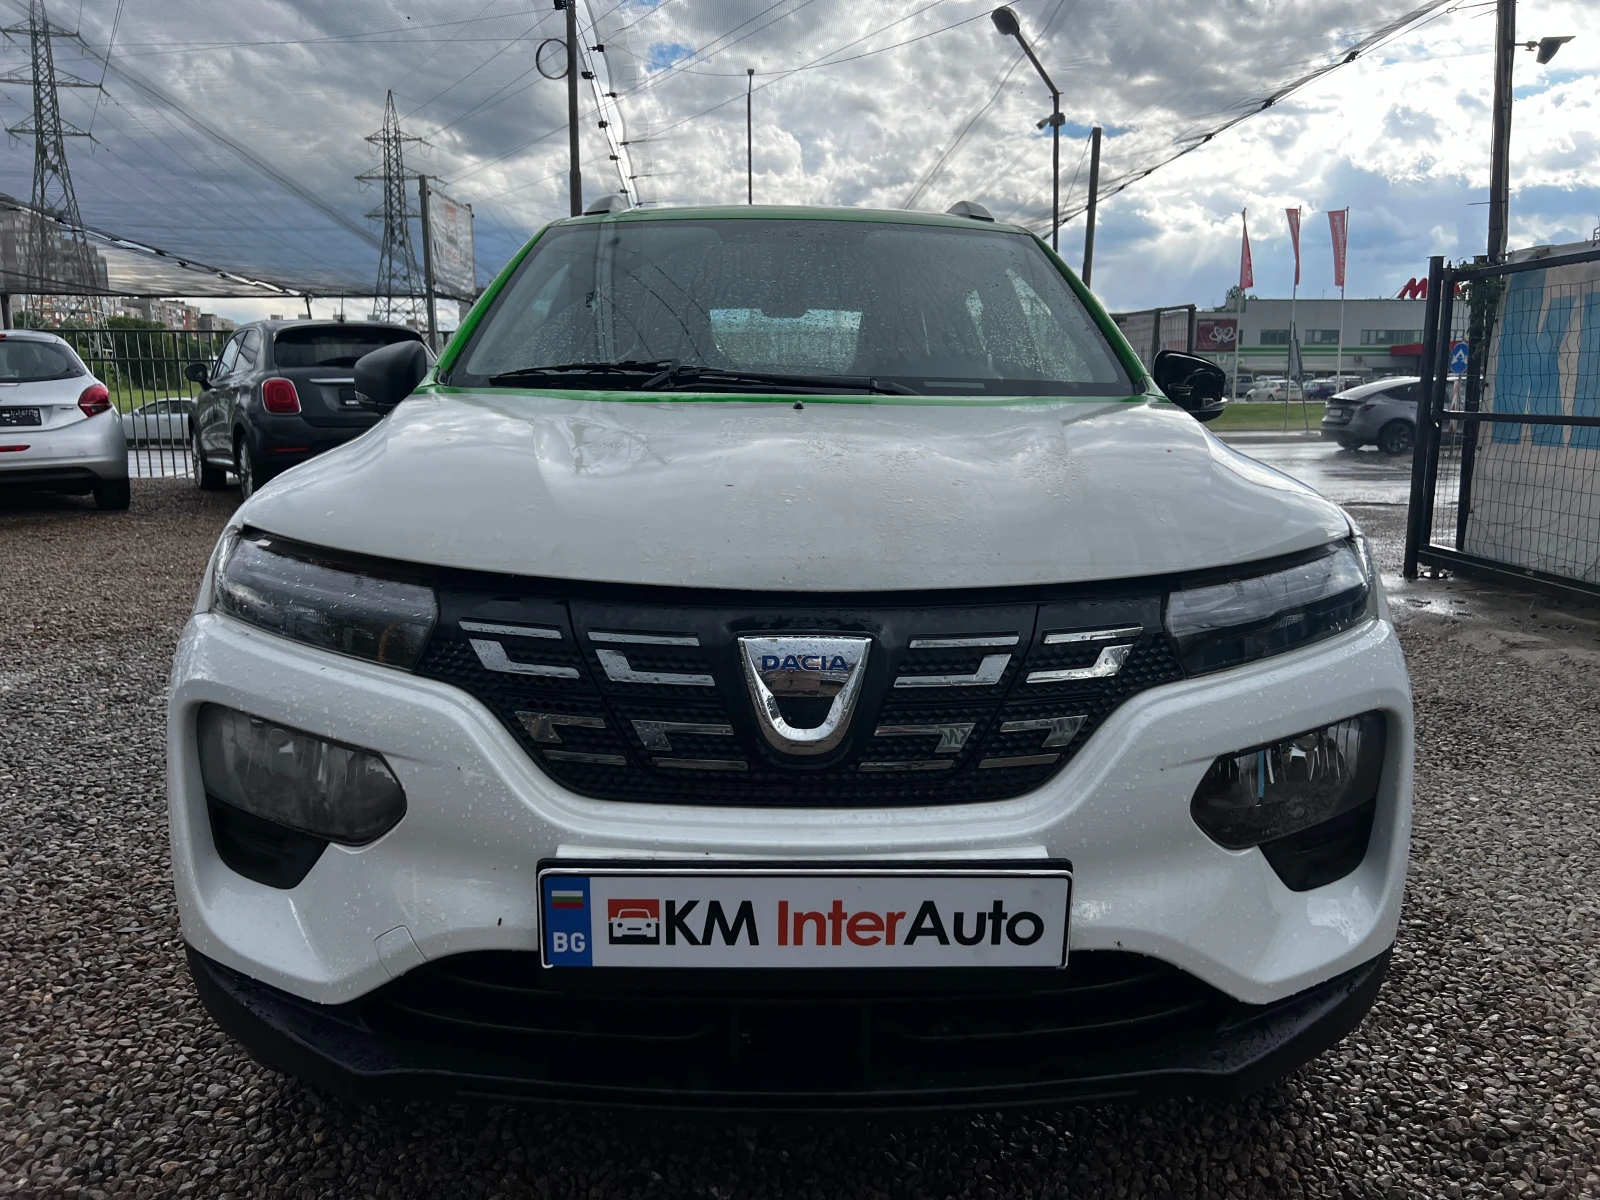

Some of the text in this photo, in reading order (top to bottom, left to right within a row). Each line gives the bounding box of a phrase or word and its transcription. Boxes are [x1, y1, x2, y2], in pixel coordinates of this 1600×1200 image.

[761, 655, 849, 671] DACIA
[665, 900, 1045, 946] KM InterAuto
[552, 931, 586, 953] BG
